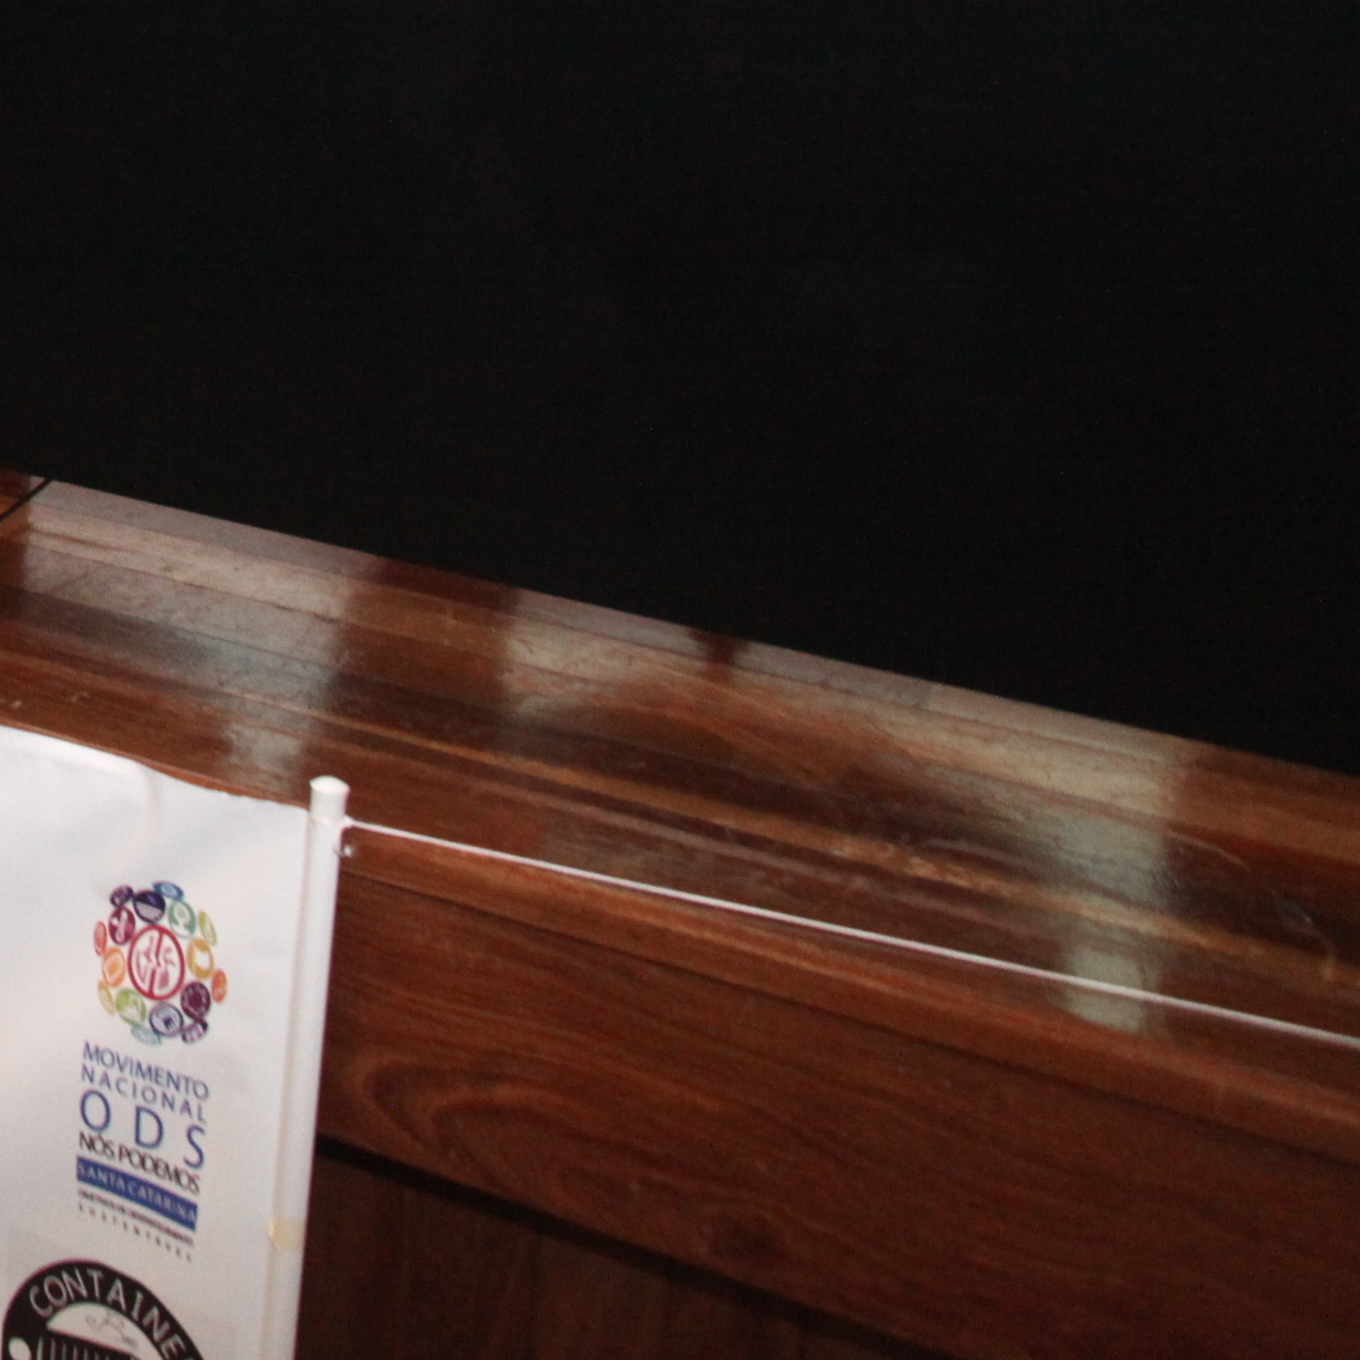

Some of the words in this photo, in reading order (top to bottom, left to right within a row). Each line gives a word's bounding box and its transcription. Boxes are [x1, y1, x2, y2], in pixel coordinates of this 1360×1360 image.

[82, 1063, 206, 1123] NACIONAL
[83, 1040, 209, 1100] MOVIMENTO
[78, 1161, 125, 1191] SANTA
[127, 1177, 197, 1223] CATARINA
[79, 1130, 114, 1157] NÓS
[119, 1145, 200, 1195] PODEMOS
[29, 1267, 193, 1360] CONTAINE
